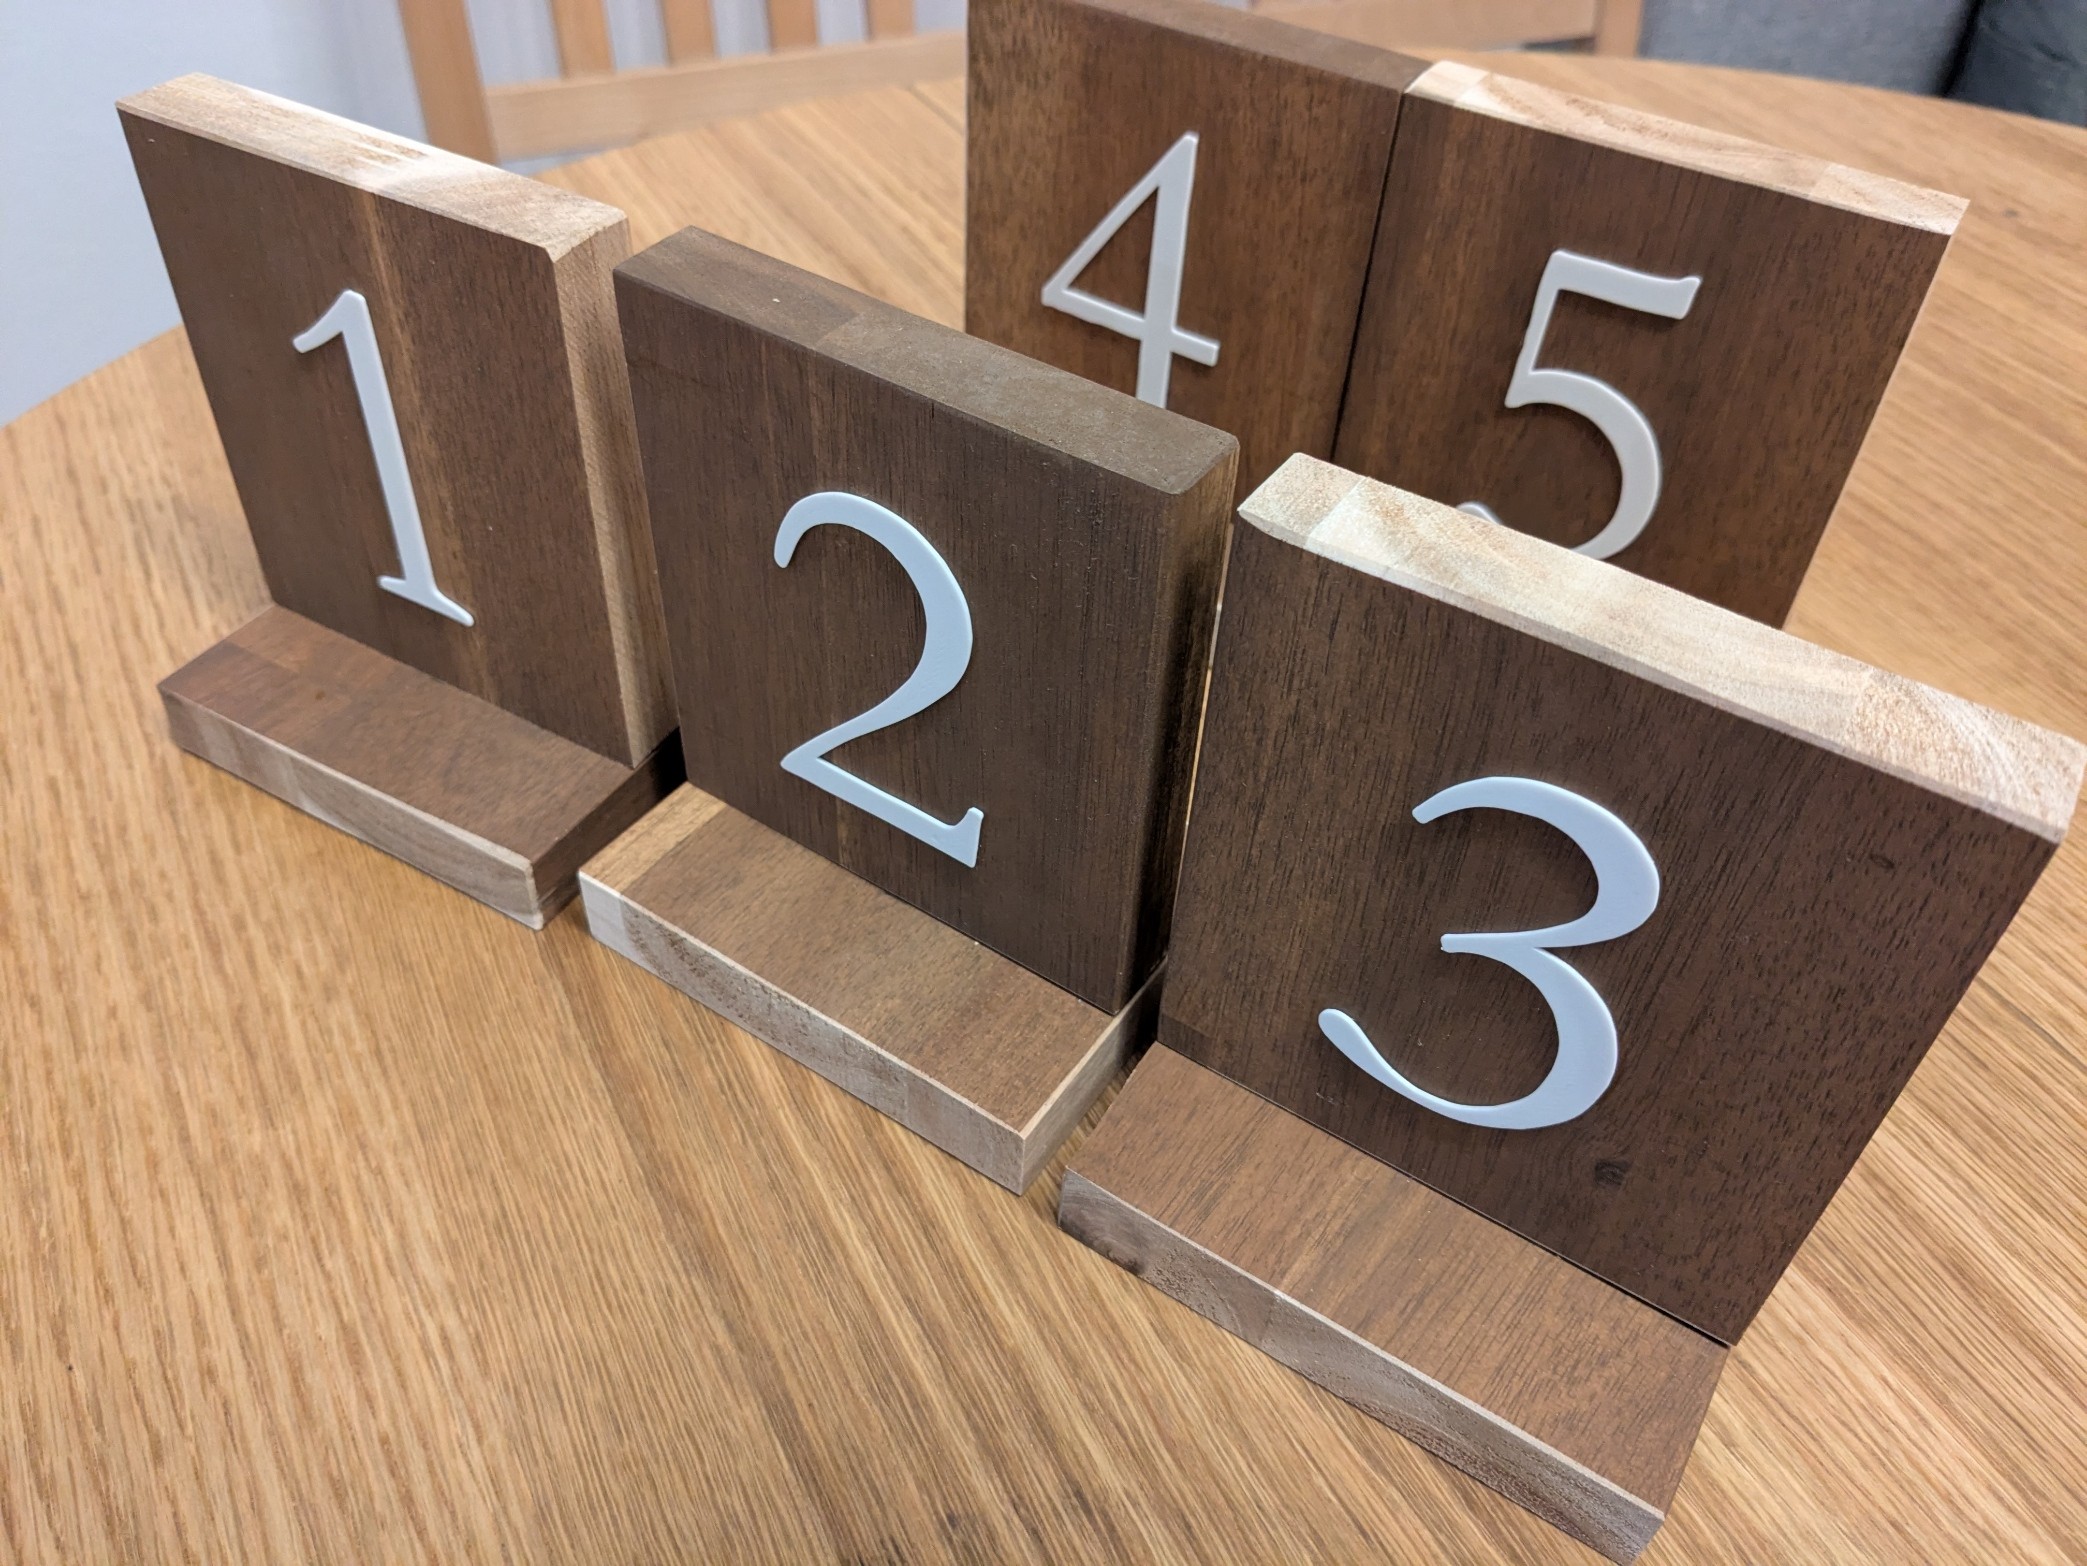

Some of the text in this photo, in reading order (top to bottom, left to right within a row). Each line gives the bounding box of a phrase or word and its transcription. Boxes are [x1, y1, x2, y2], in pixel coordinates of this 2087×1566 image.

[1041, 131, 1221, 410] 4
[1454, 249, 1702, 561] 5
[291, 288, 475, 628] 1
[773, 490, 985, 869] 2
[1318, 775, 1662, 1131] 3
